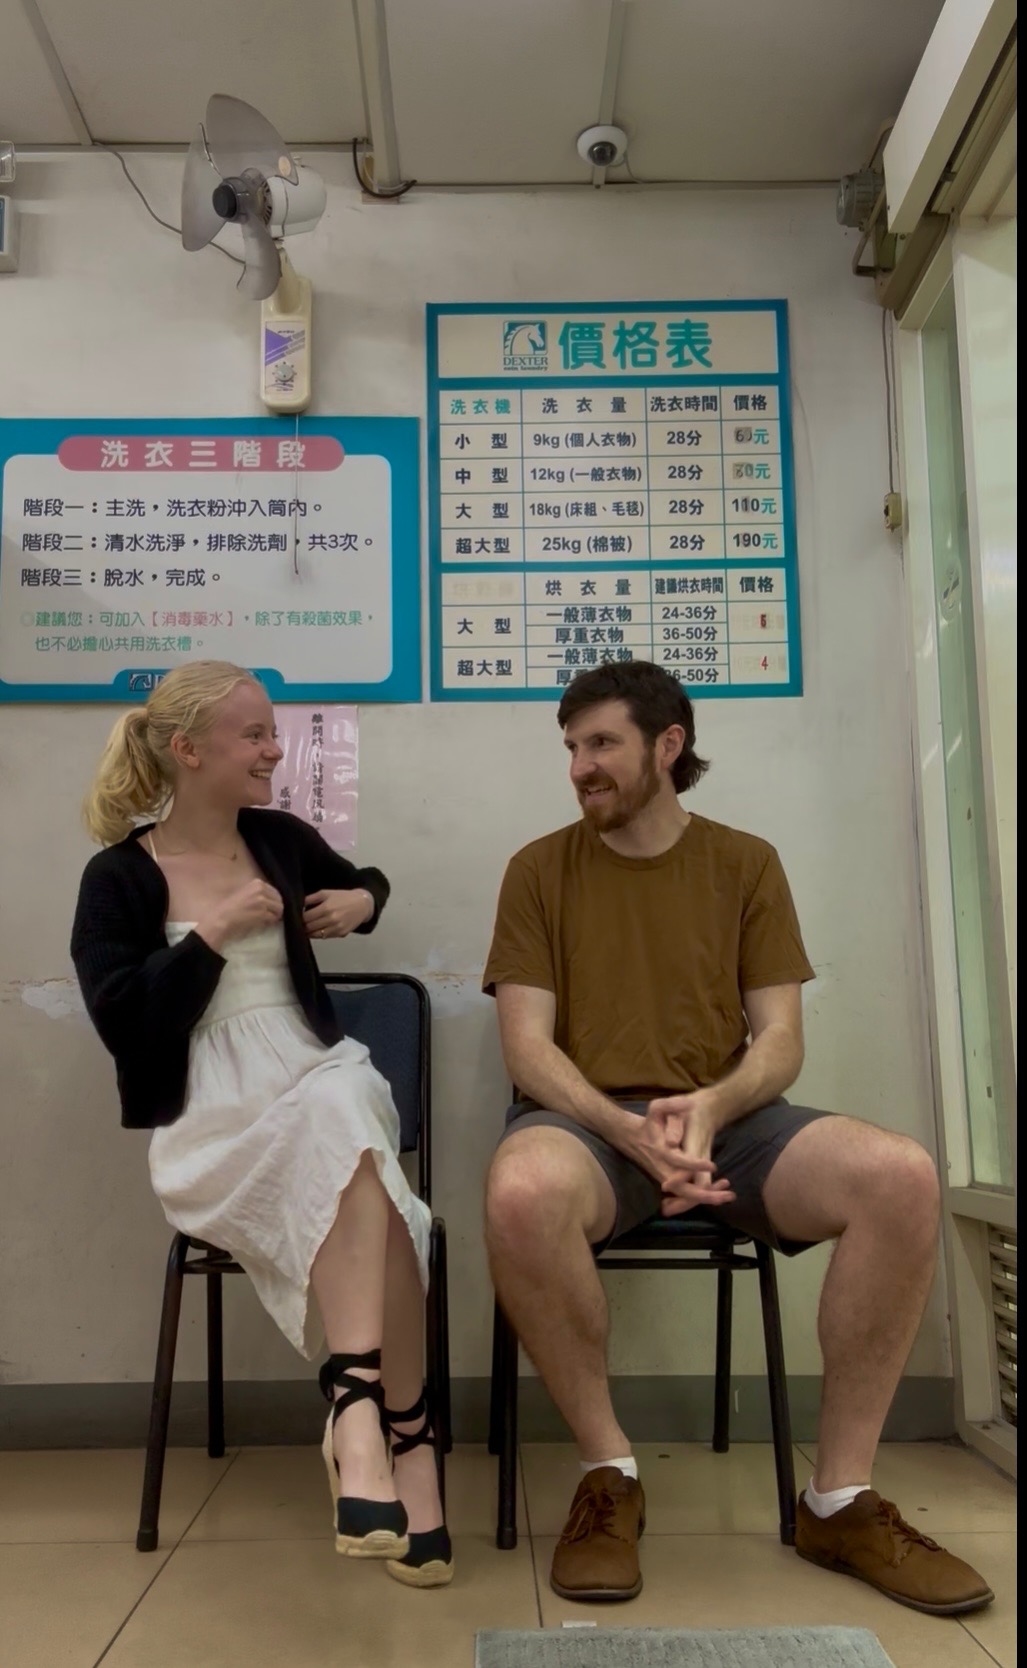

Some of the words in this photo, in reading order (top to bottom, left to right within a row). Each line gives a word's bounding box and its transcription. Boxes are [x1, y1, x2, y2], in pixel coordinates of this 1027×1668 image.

[558, 318, 713, 370] 價格表
[503, 357, 548, 366] DEXTER
[450, 399, 511, 416] 洗衣機
[542, 397, 627, 414] 洗衣量
[650, 395, 718, 413] 洗衣時間
[733, 394, 768, 412] 價格
[455, 432, 508, 449] 小型
[533, 433, 560, 449] 9kg
[564, 431, 637, 448] (個人衣物)
[667, 430, 702, 446] 28分
[101, 440, 306, 468] 洗衣三階段
[455, 468, 509, 484] 中型
[530, 468, 565, 483] 12kg
[569, 466, 642, 483] (一般衣物)
[668, 465, 704, 481] 28分
[455, 502, 510, 520] 大型
[530, 502, 561, 518] 18kg
[564, 501, 644, 518] (床組、毛毯)
[668, 499, 705, 516] 28分
[732, 498, 777, 514] 110元
[455, 538, 510, 554] 超大型
[542, 537, 582, 554] 25kg
[586, 536, 633, 554] (棉被)
[670, 534, 706, 550] 28分
[732, 533, 778, 550] 190元
[545, 580, 632, 596] 烘衣量
[654, 577, 724, 595] 建議烘衣時間
[739, 576, 774, 594] 價格
[546, 606, 632, 623] 一般薄衣物
[662, 604, 718, 621] 24-36分
[457, 618, 512, 635] 大型
[555, 626, 624, 644] 厚重衣物
[662, 626, 718, 642] 36-50分
[547, 647, 634, 665] 一般薄衣物
[663, 646, 718, 663] 24-36分
[457, 660, 512, 676] 超大型
[760, 655, 769, 672] 4
